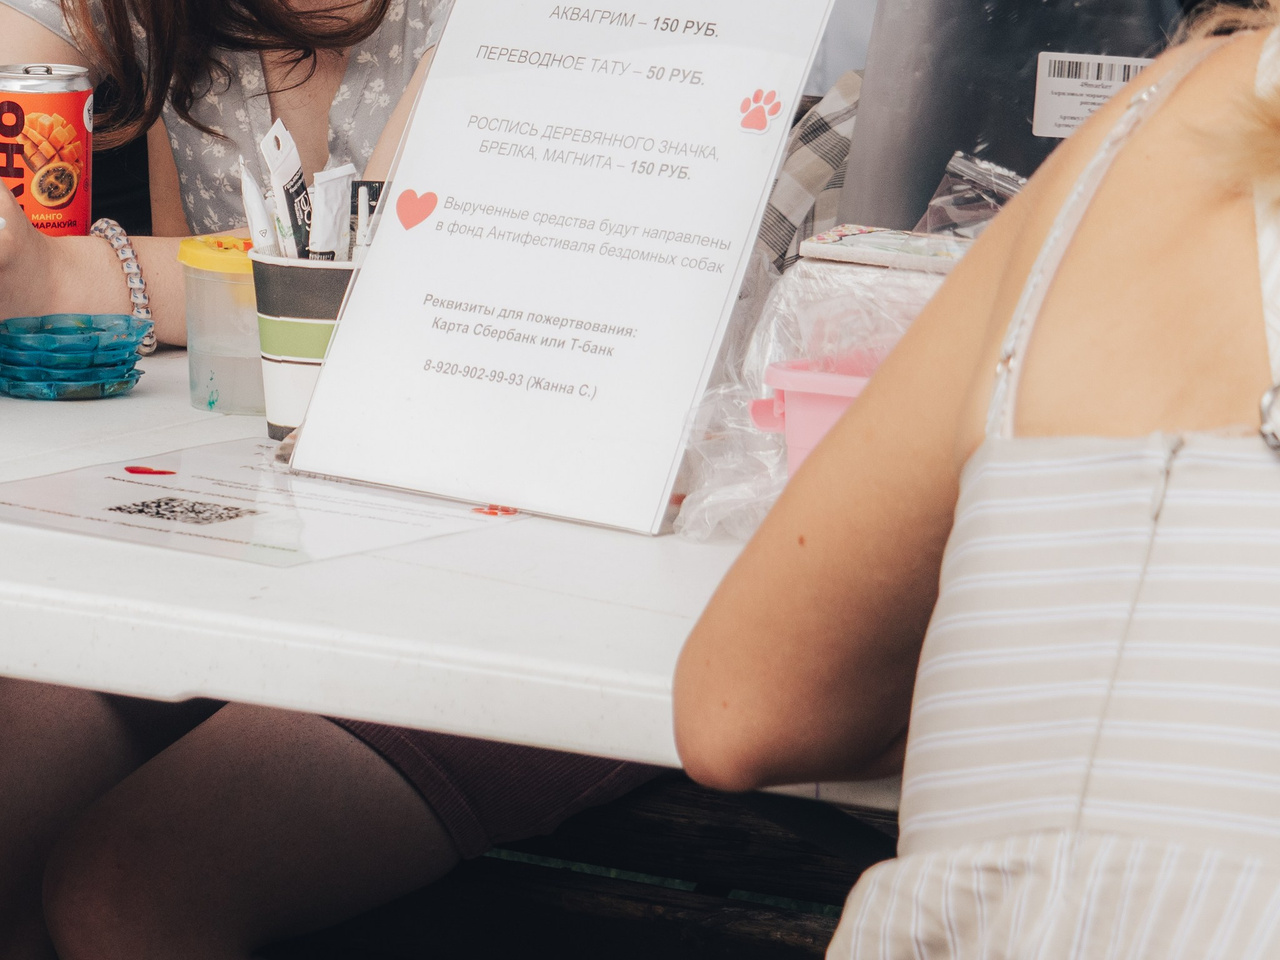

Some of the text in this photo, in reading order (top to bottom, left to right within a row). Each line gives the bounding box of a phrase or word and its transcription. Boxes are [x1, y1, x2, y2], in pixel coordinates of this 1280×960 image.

[549, 5, 636, 28] АКВАГРИМ
[652, 17, 680, 33] 150
[683, 20, 719, 38] РУБ.
[476, 45, 587, 71] ПЕРЕВОДНОЕ
[590, 58, 631, 76] ТАТУ
[646, 65, 666, 81] 50
[669, 68, 705, 86] РУБ.
[467, 115, 719, 162] РОСПИСЬ ДЕРЕВЯННОГО ЗНАЧКА,
[478, 139, 538, 162] БРЕЛКА,
[542, 148, 612, 170] МАГНИТА
[630, 159, 655, 176] 150
[657, 163, 691, 181] РУБ.
[31, 213, 63, 222] МАНГО
[443, 196, 732, 252] Вырученные средства будут направлены
[435, 219, 725, 275] в фонд Антифестиваля бездомных собак
[423, 293, 639, 339] Реквизиты для пожертвования:
[431, 316, 615, 357] Карта Сбербанк или Т-банк
[423, 358, 598, 401] 8-920-902-99-93 (Жанна С.)
